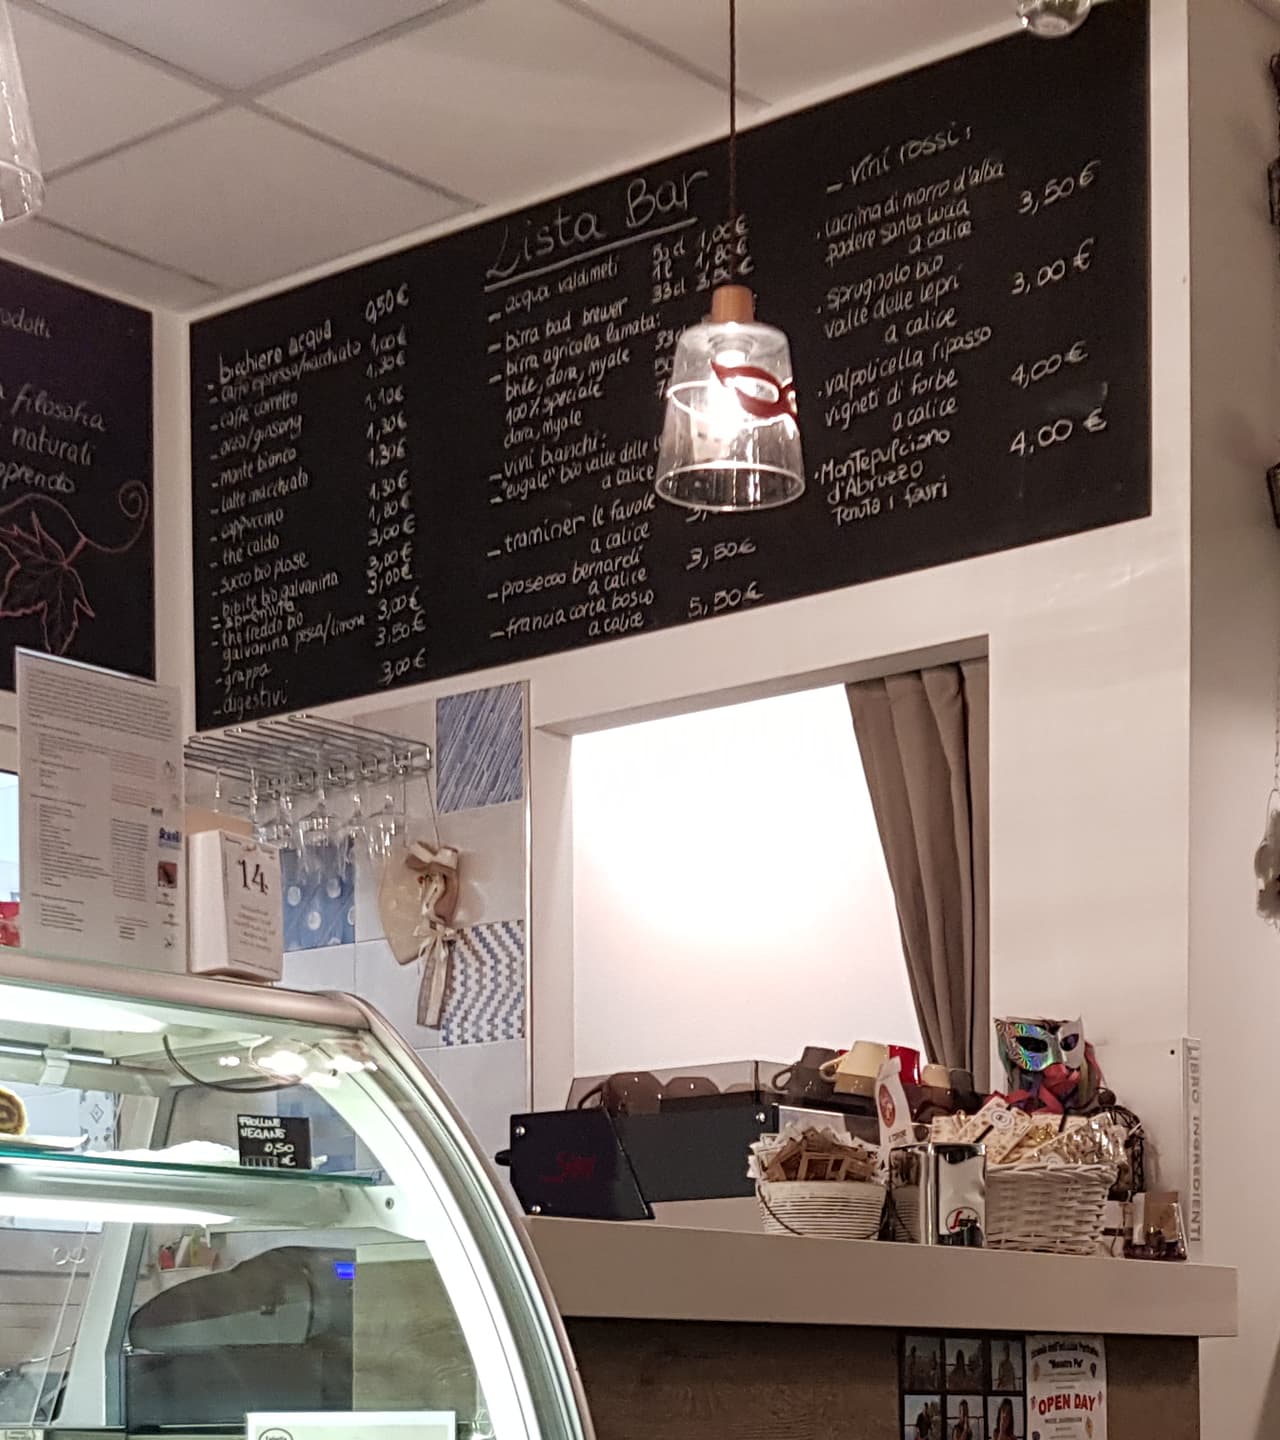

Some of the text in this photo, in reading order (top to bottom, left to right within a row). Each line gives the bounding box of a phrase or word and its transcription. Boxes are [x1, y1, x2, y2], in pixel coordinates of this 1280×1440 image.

[486, 170, 709, 278] Lista Bar
[825, 205, 881, 238] lacrima
[903, 178, 950, 209] morro
[825, 228, 876, 266] podere
[880, 213, 922, 245] santa
[927, 220, 972, 248] calice
[505, 285, 552, 313] acqua
[825, 263, 963, 339] valle delle lepri
[826, 261, 910, 311] sprugnolo
[506, 296, 629, 351] birra bad brewer
[905, 306, 958, 338] calice
[506, 356, 540, 377] birra
[543, 334, 601, 369] agricola
[825, 325, 992, 401] valpolicella ripasso
[10, 382, 106, 432] filosofia
[825, 387, 880, 431] vigneti
[907, 396, 959, 427] calice
[11, 424, 96, 467] naturali
[820, 428, 950, 484] Montepulciano
[616, 463, 655, 485] calice
[827, 460, 925, 504] d'Abruzzo
[504, 515, 586, 554] traminer
[610, 492, 657, 523] favole
[832, 499, 881, 526] Tenuta
[605, 521, 651, 549] calice
[572, 545, 644, 584] bernardi
[603, 567, 648, 591] calice
[603, 610, 645, 632] calice
[1187, 1046, 1201, 1242] LIBRO INGREDIENTI
[1038, 1393, 1096, 1415] OPEN DAY
